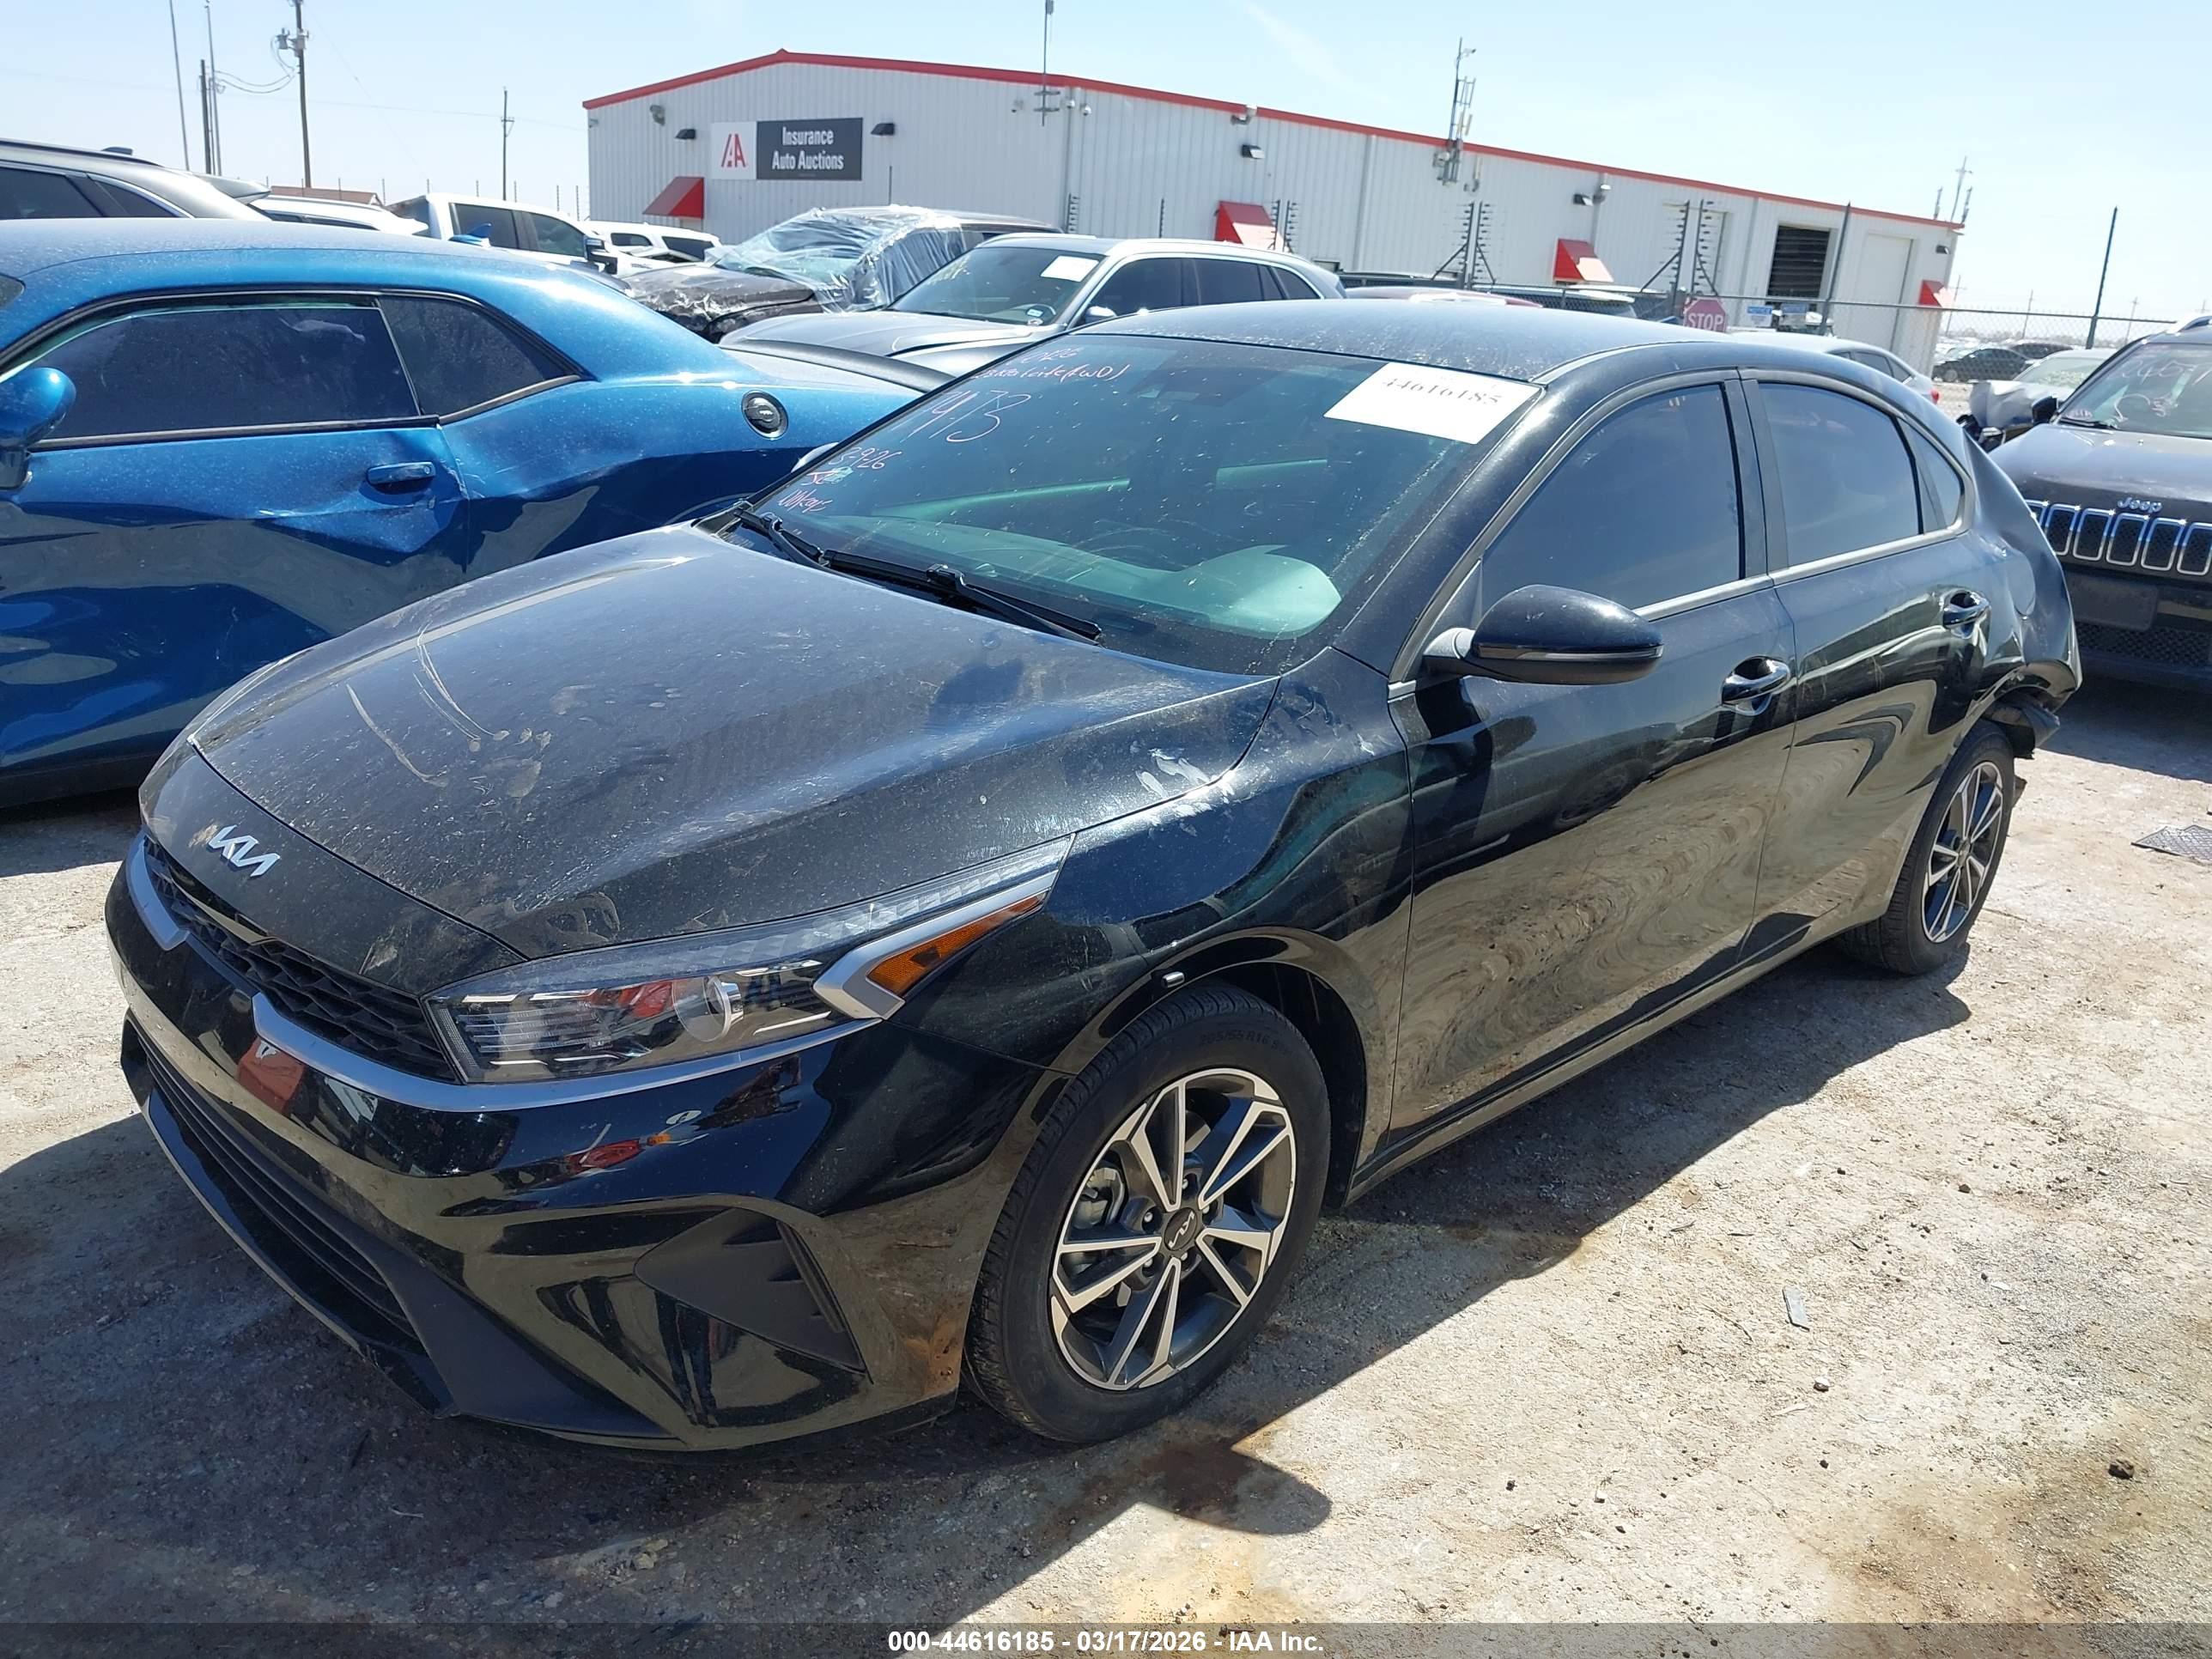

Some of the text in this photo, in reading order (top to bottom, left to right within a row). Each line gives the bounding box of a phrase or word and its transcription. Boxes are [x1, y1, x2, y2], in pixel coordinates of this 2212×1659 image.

[782, 127, 834, 146] Insurance
[772, 150, 844, 170] Auto Auctions
[1688, 313, 1724, 331] STOP
[2117, 496, 2163, 514] Jeep
[208, 823, 282, 878] KIA
